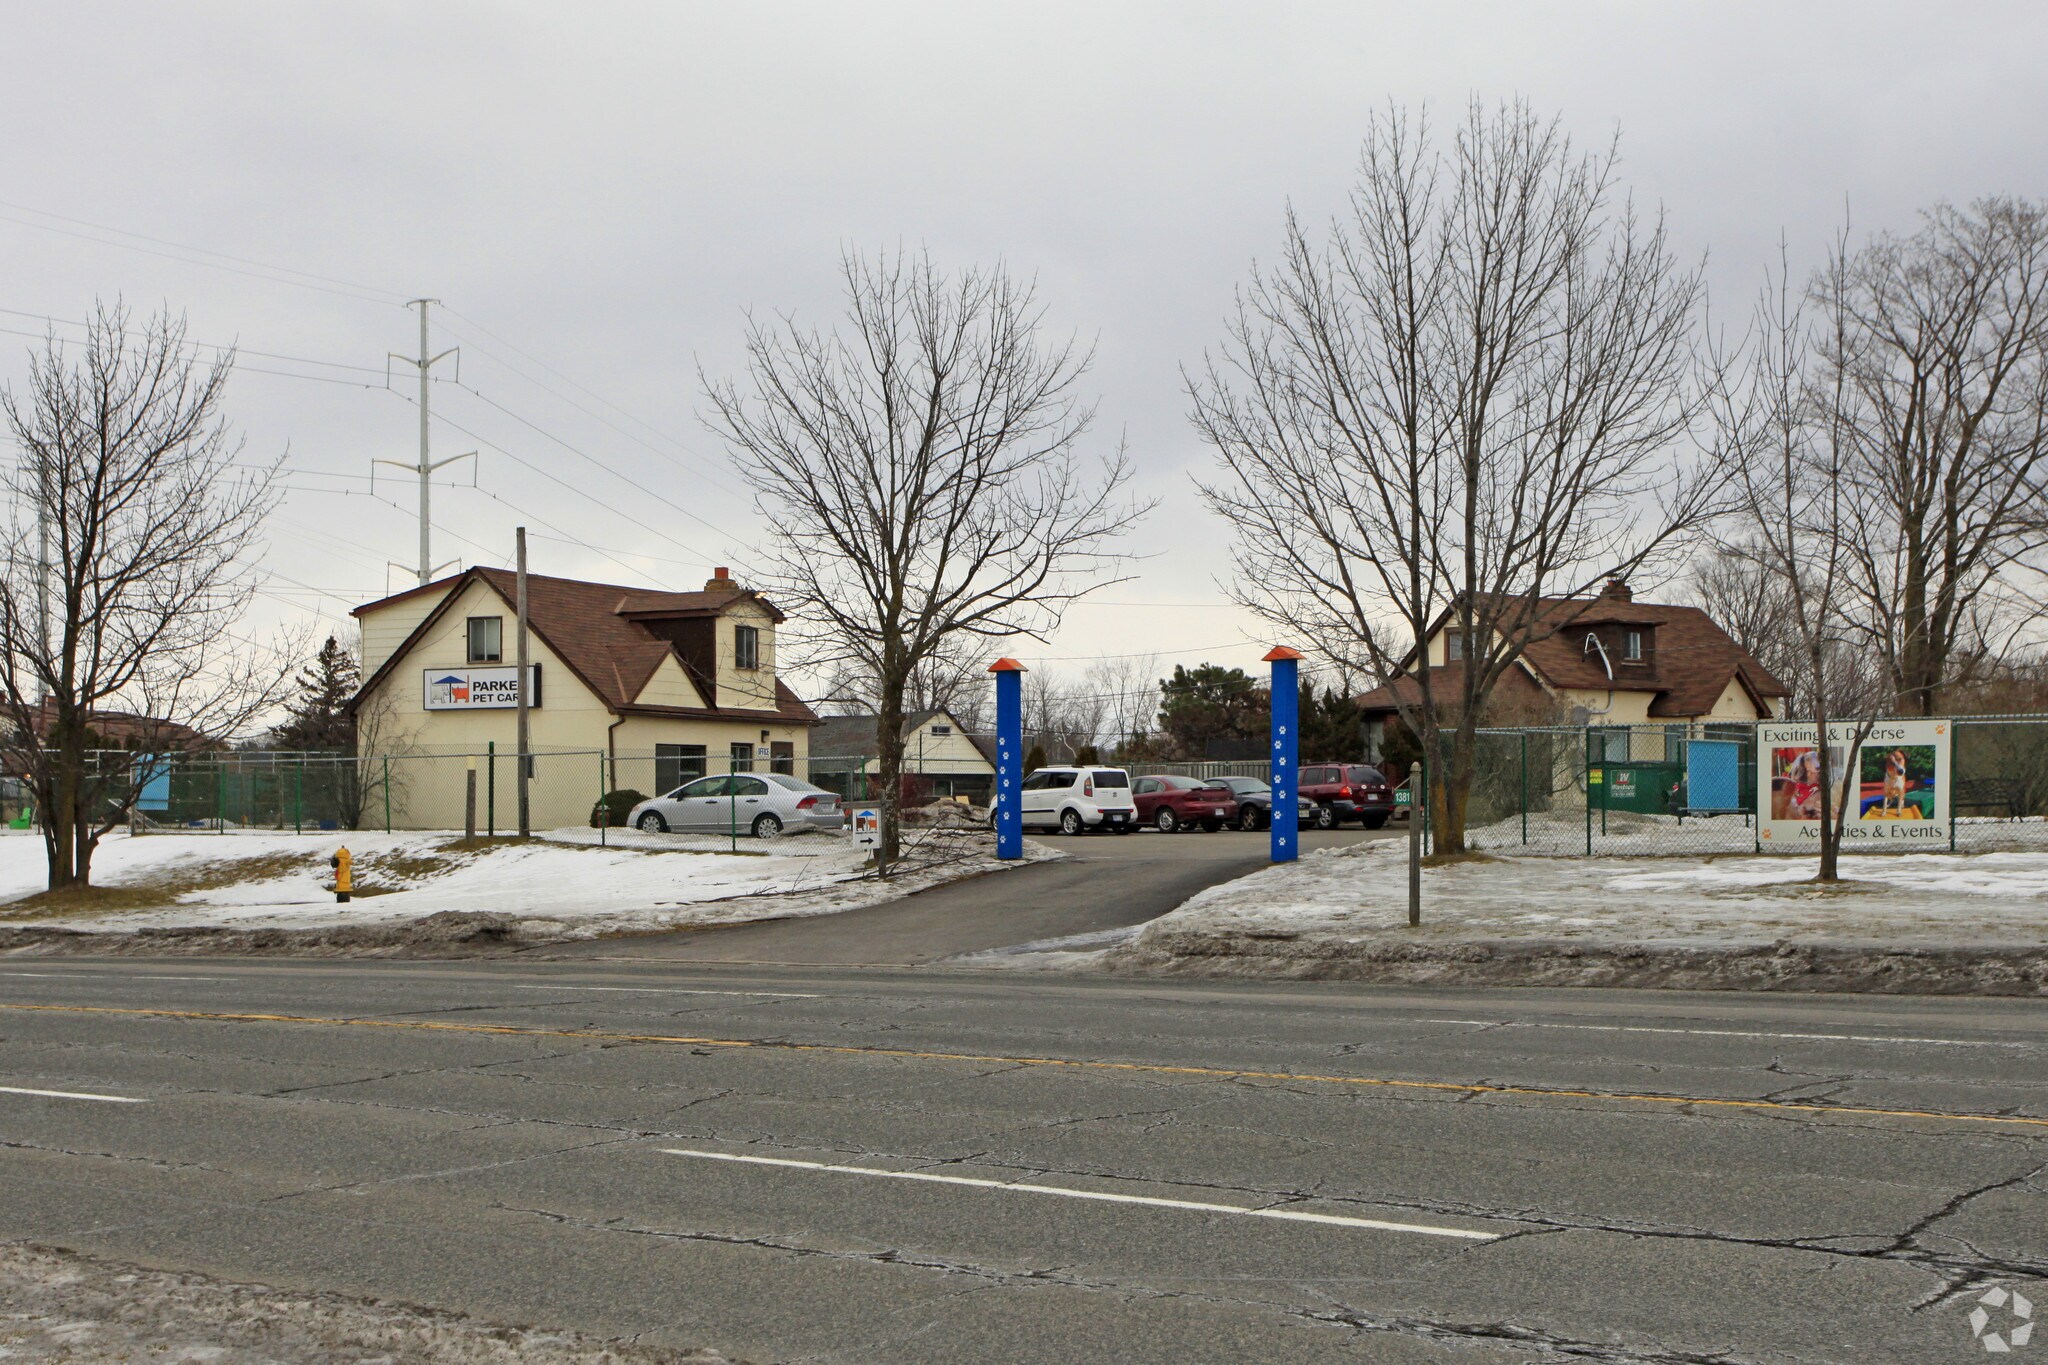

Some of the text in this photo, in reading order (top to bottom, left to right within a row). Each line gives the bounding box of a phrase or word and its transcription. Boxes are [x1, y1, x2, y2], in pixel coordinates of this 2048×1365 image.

[473, 680, 517, 692] PARKE
[473, 693, 519, 703] PET CAR
[1764, 727, 1905, 745] Exciting & Derse
[1395, 792, 1410, 802] 1381
[1799, 823, 1943, 839] Acties & Events
